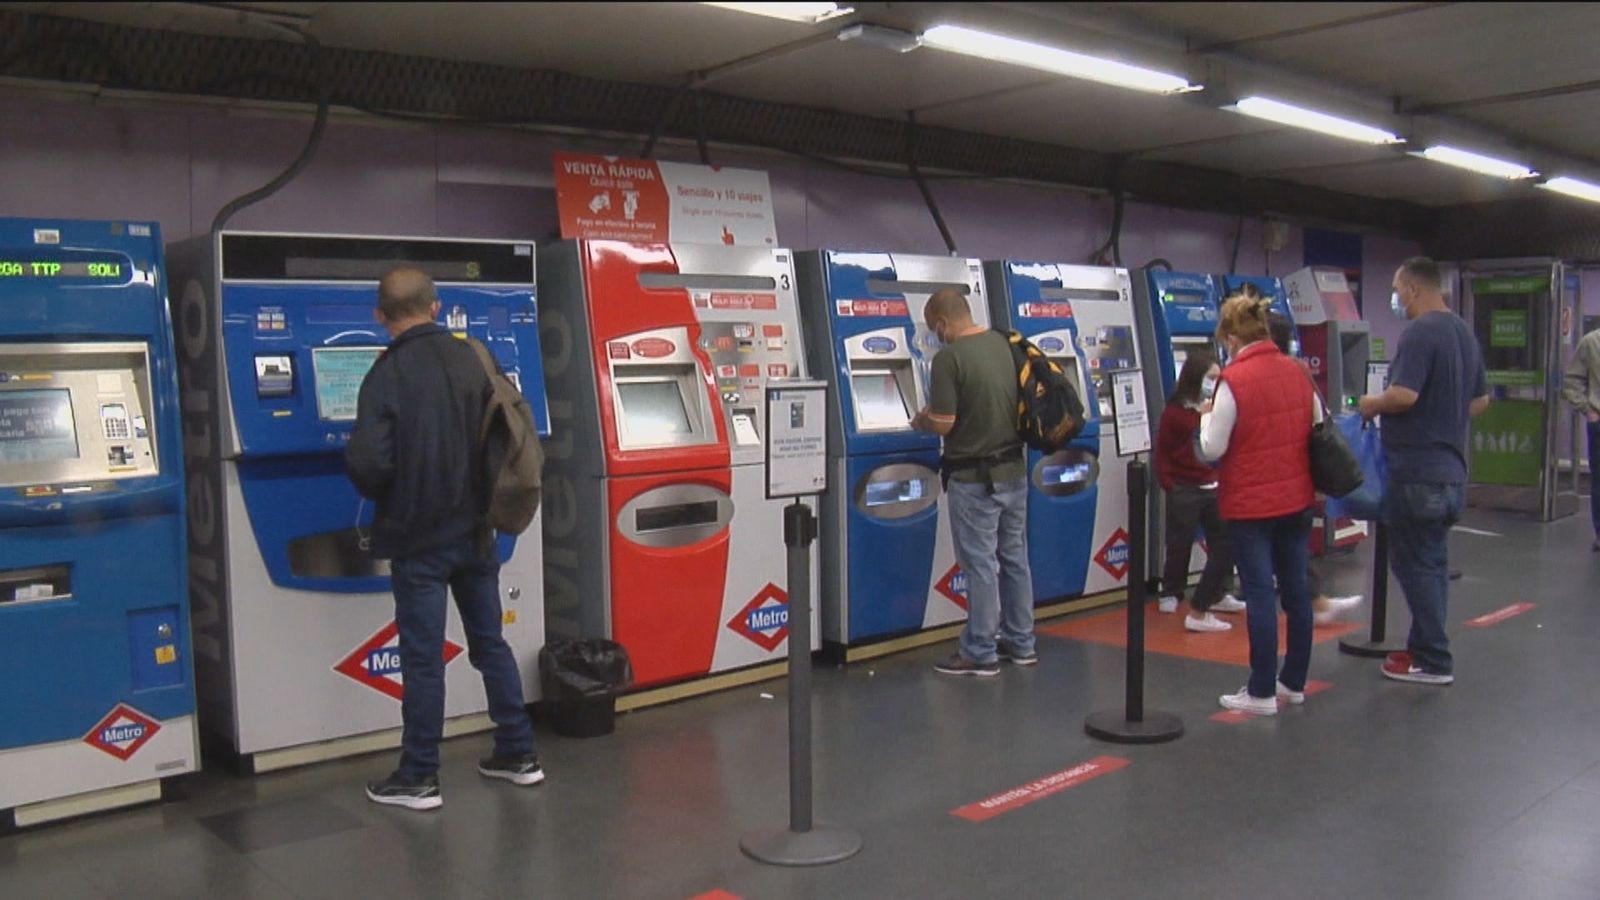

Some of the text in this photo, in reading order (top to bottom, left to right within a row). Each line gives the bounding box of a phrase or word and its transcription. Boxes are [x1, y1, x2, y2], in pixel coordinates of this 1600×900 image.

[563, 161, 655, 180] VENTA RÁPIDA
[677, 185, 714, 198] Sencillo
[724, 189, 735, 199] 10
[737, 191, 763, 203] viajes
[31, 262, 60, 276] TTP
[780, 274, 790, 291] 3
[974, 281, 981, 297] 4
[104, 725, 142, 743] Metro
